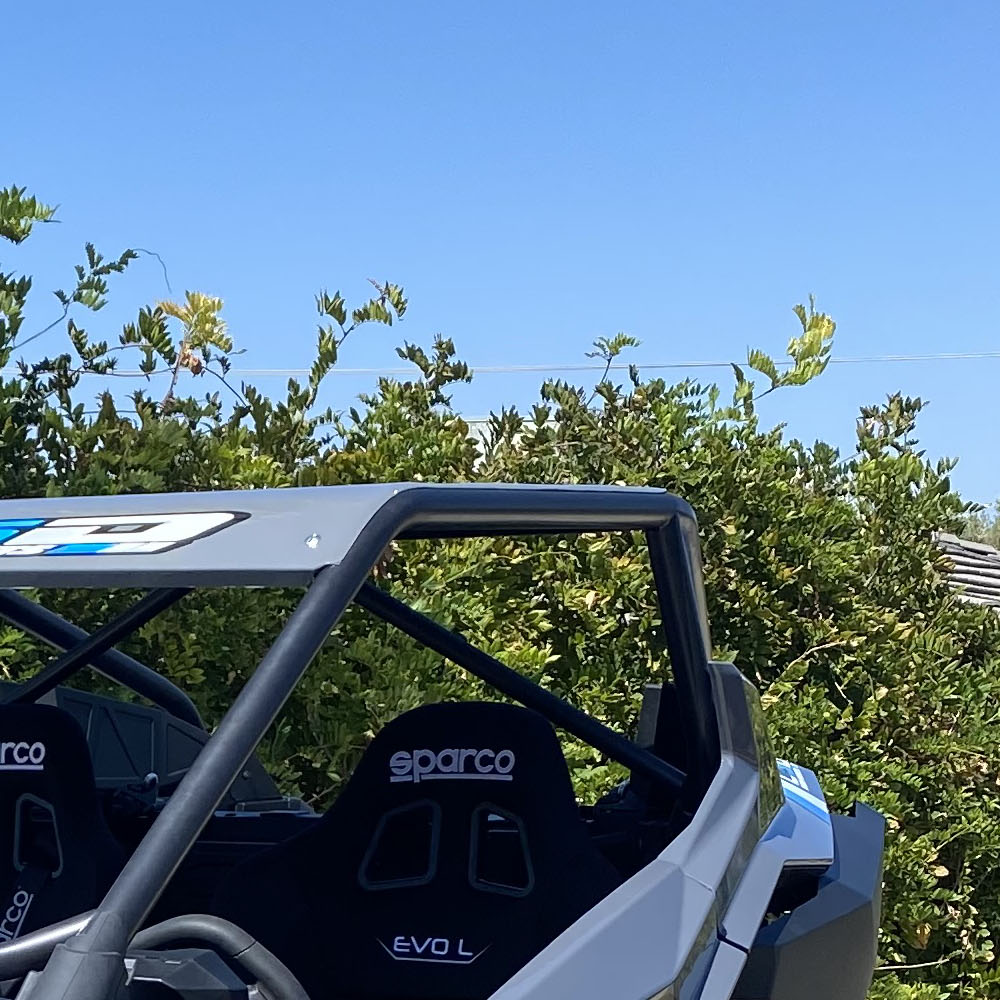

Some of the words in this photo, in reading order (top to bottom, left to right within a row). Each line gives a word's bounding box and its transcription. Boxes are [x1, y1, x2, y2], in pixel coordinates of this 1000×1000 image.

[389, 748, 516, 783] sparco
[393, 936, 450, 955] EVO
[458, 938, 474, 956] L
